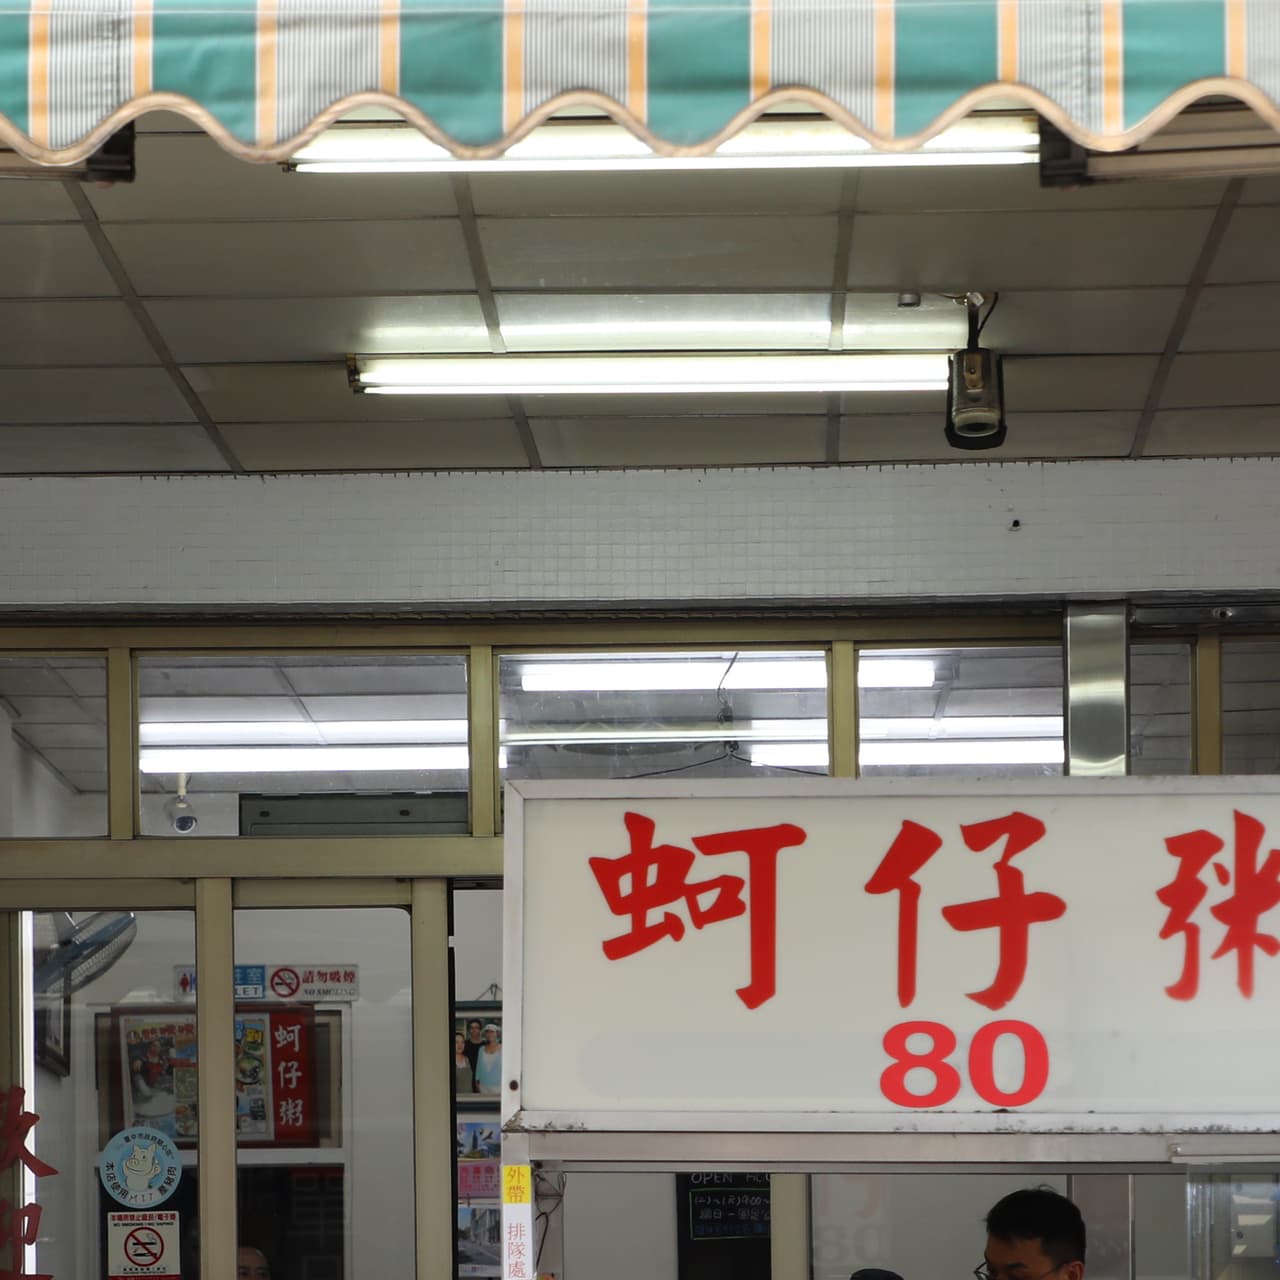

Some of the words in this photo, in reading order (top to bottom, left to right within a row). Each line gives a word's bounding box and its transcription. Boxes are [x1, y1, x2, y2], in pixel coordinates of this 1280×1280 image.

[275, 1024, 304, 1128] 蚵仔粥
[879, 1020, 1050, 1108] 80
[508, 1167, 525, 1203] 外帶
[508, 1223, 527, 1279] 排隊處
